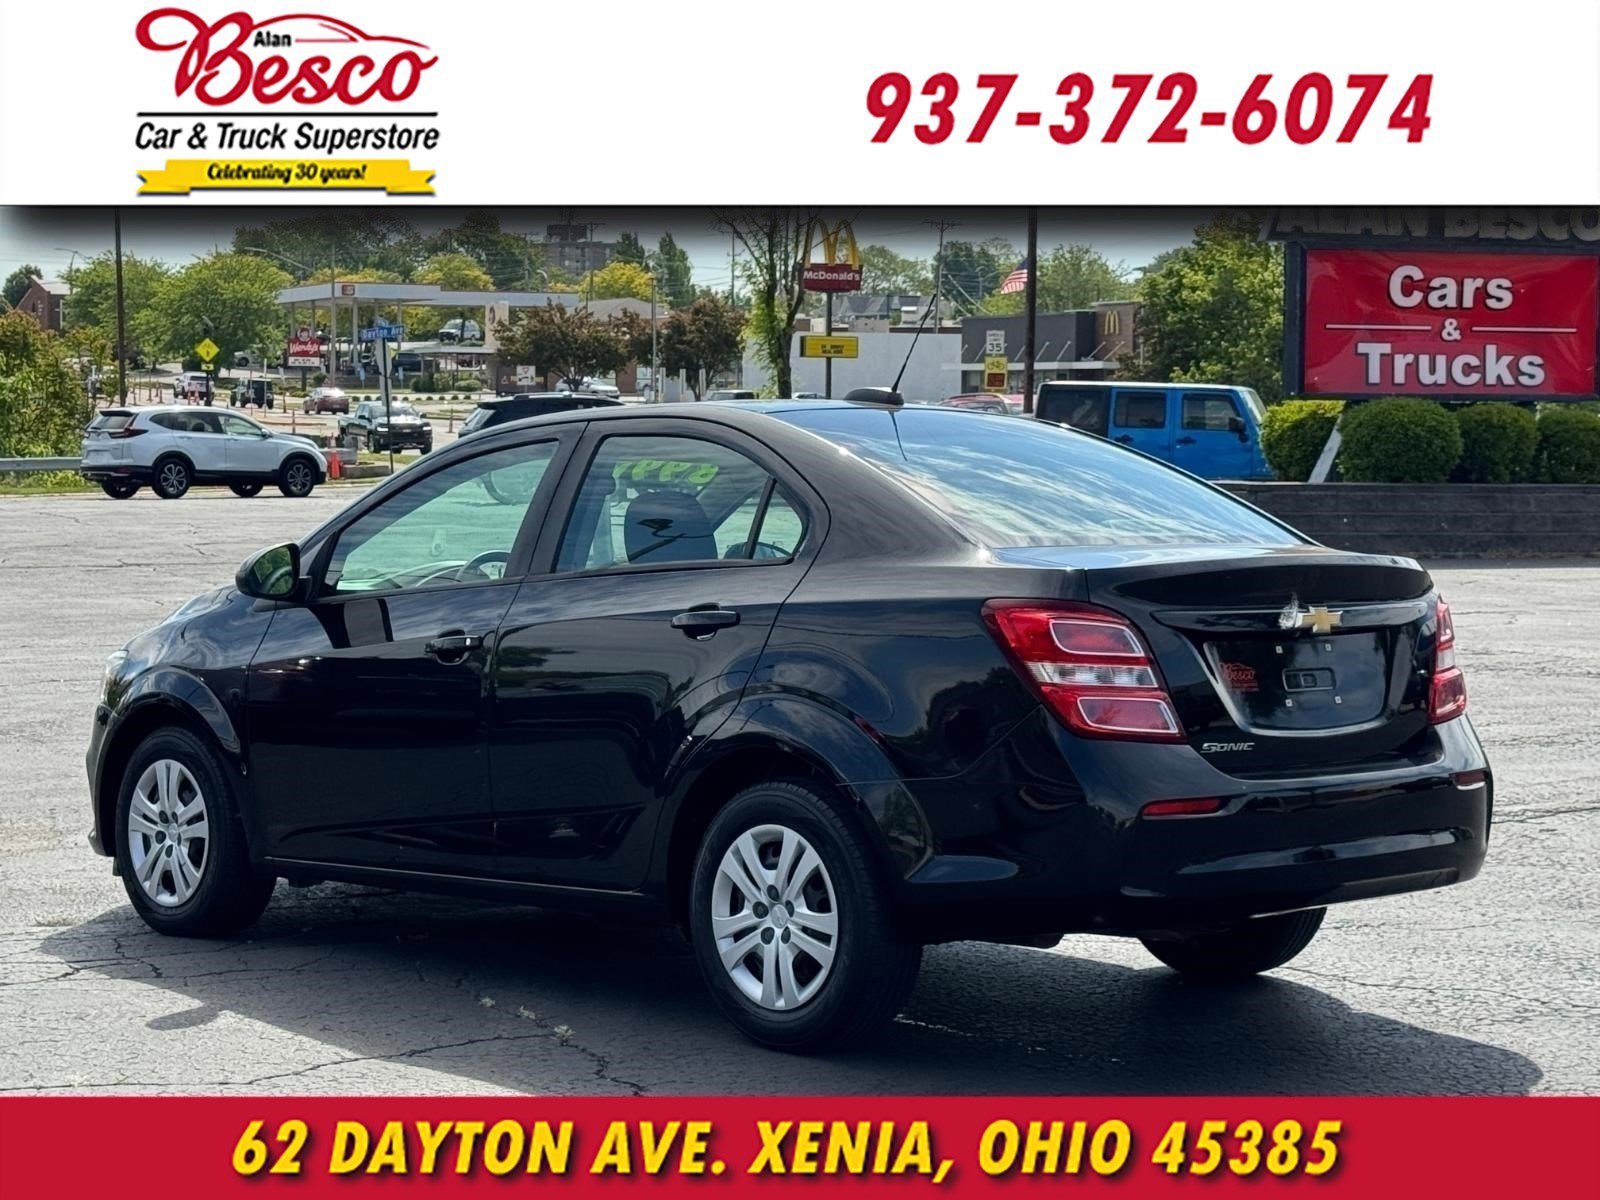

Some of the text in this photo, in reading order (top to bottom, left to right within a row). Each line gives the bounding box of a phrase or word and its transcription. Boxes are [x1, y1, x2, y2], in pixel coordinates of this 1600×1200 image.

[803, 270, 860, 282] McDonald's
[1388, 265, 1513, 310] Cars
[1440, 318, 1461, 341] &
[988, 343, 1002, 352] 35
[1357, 342, 1546, 387] Trucks
[1200, 742, 1256, 754] SONIC
